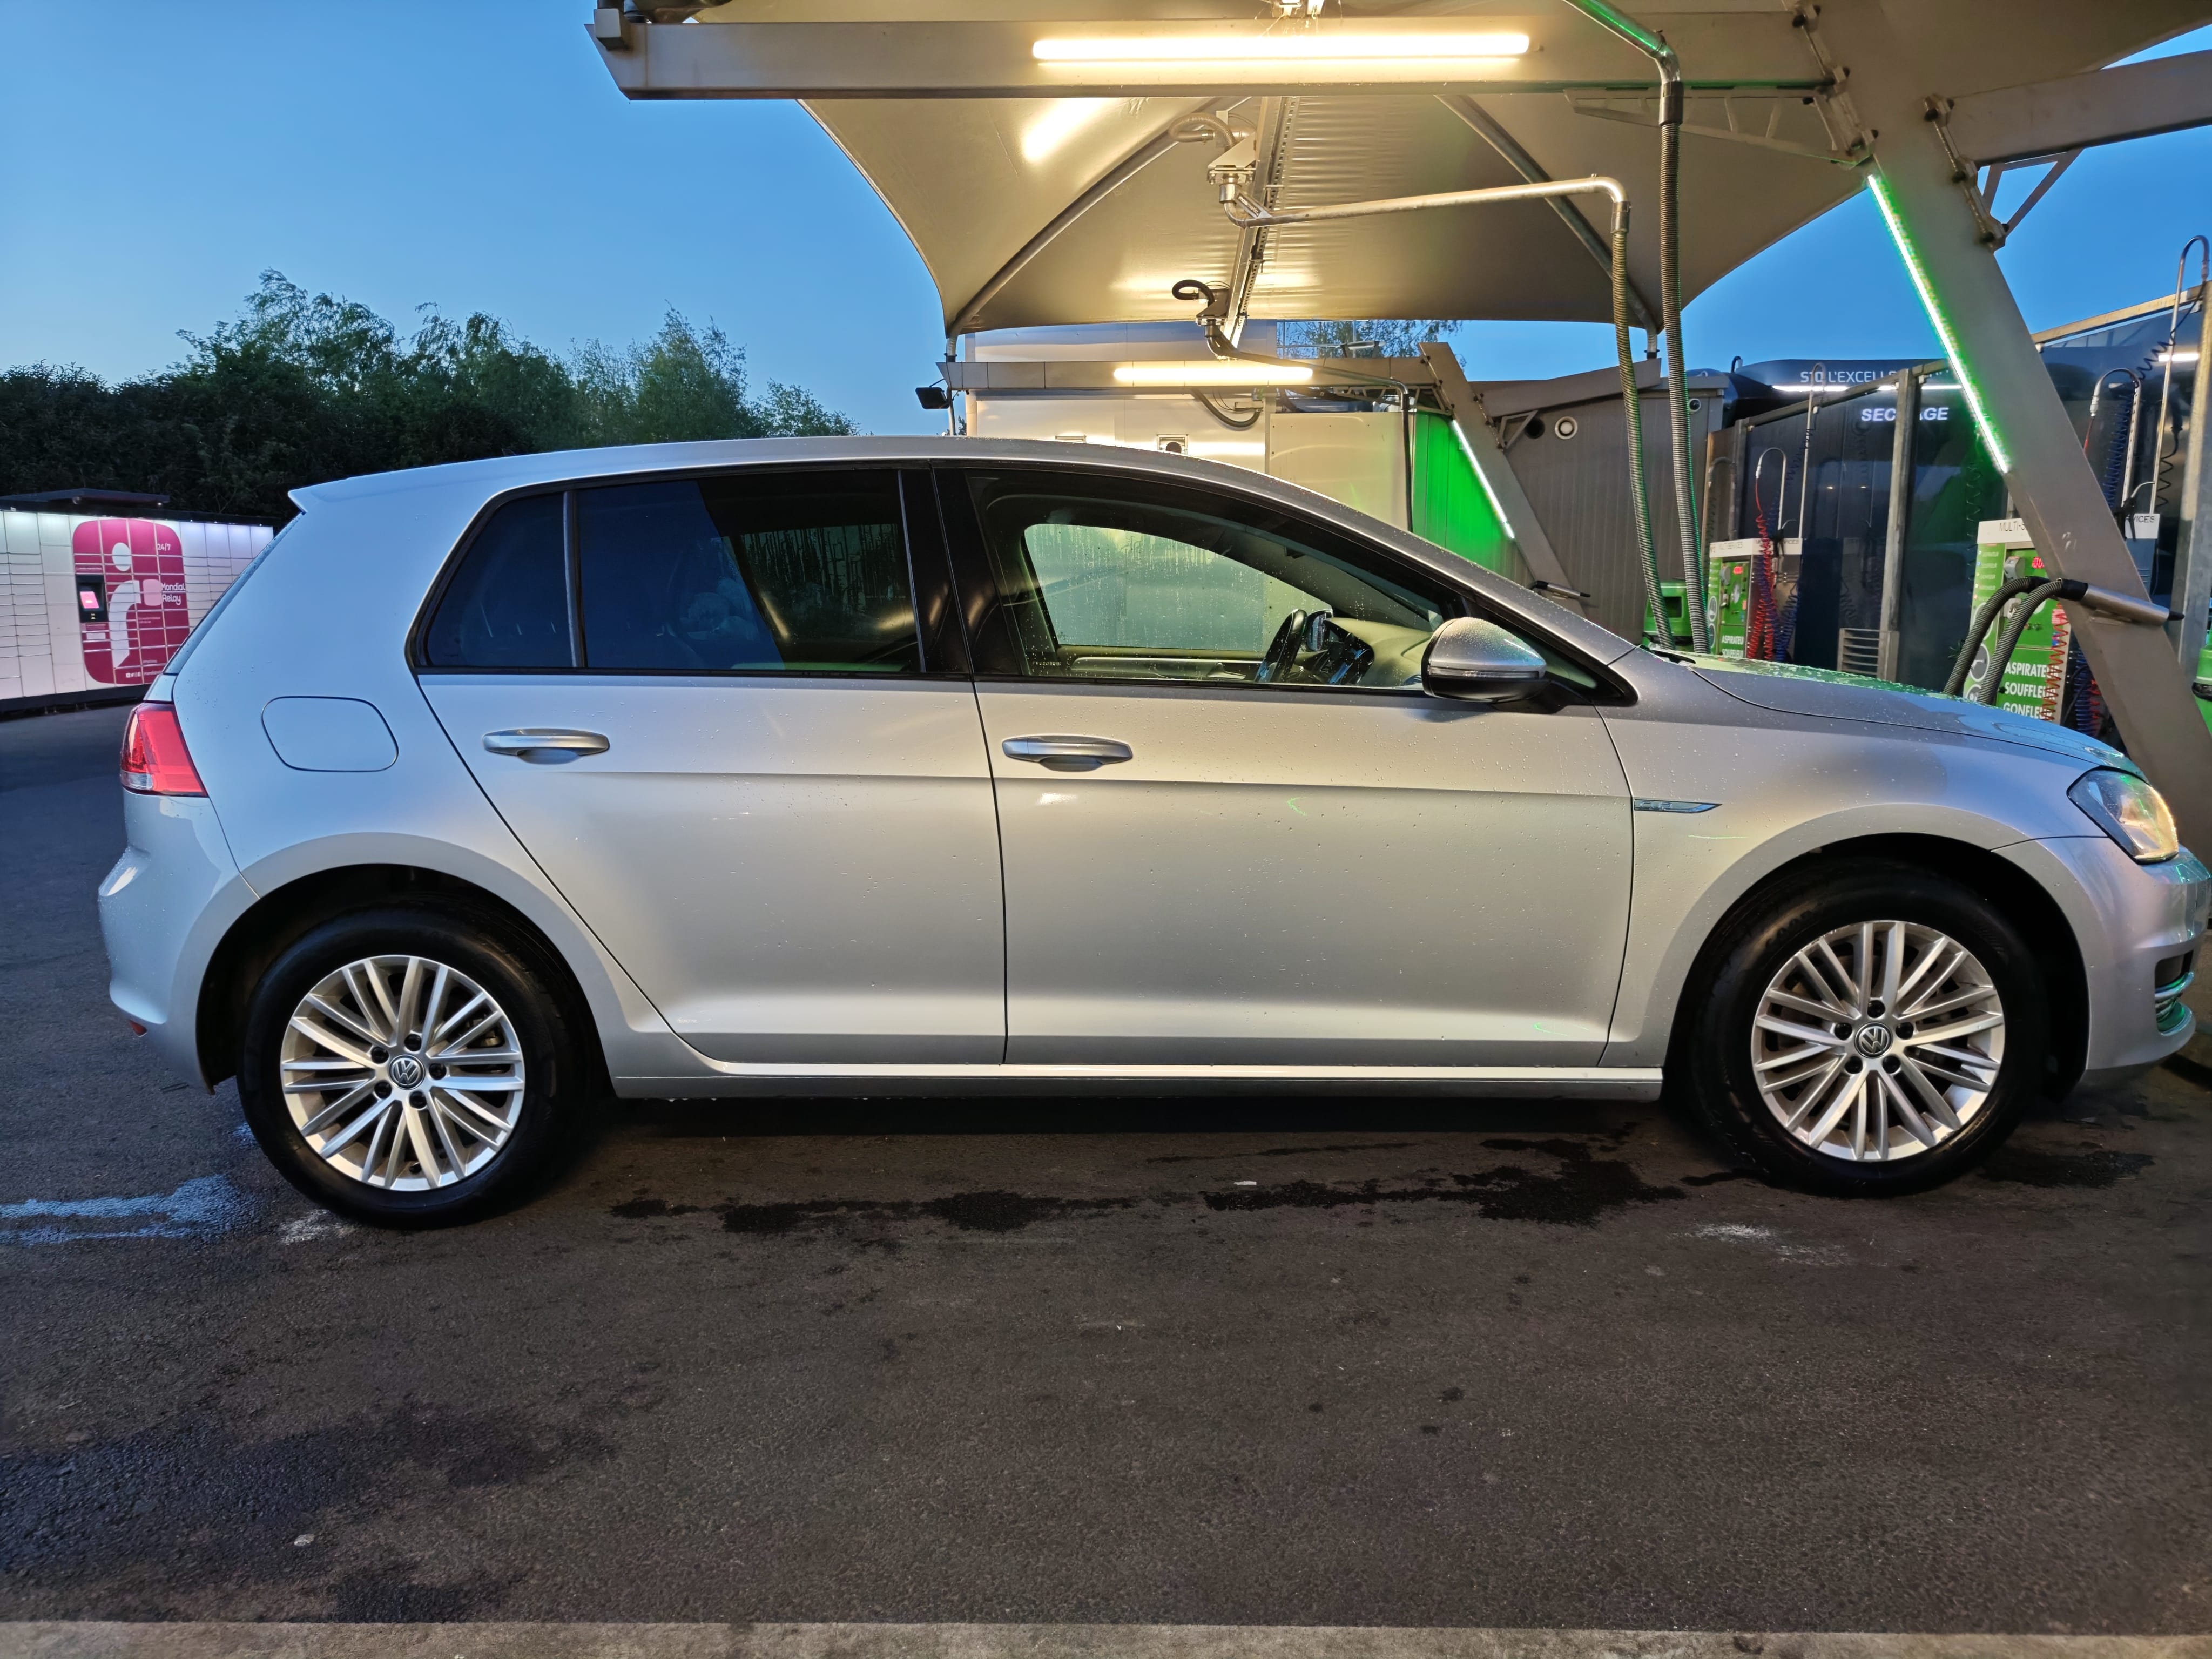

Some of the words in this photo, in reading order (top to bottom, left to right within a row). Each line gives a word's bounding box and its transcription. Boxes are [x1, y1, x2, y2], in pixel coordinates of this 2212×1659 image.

[1862, 407, 1949, 421] SECGE
[158, 543, 171, 551] 24/7
[162, 594, 181, 605] Relay
